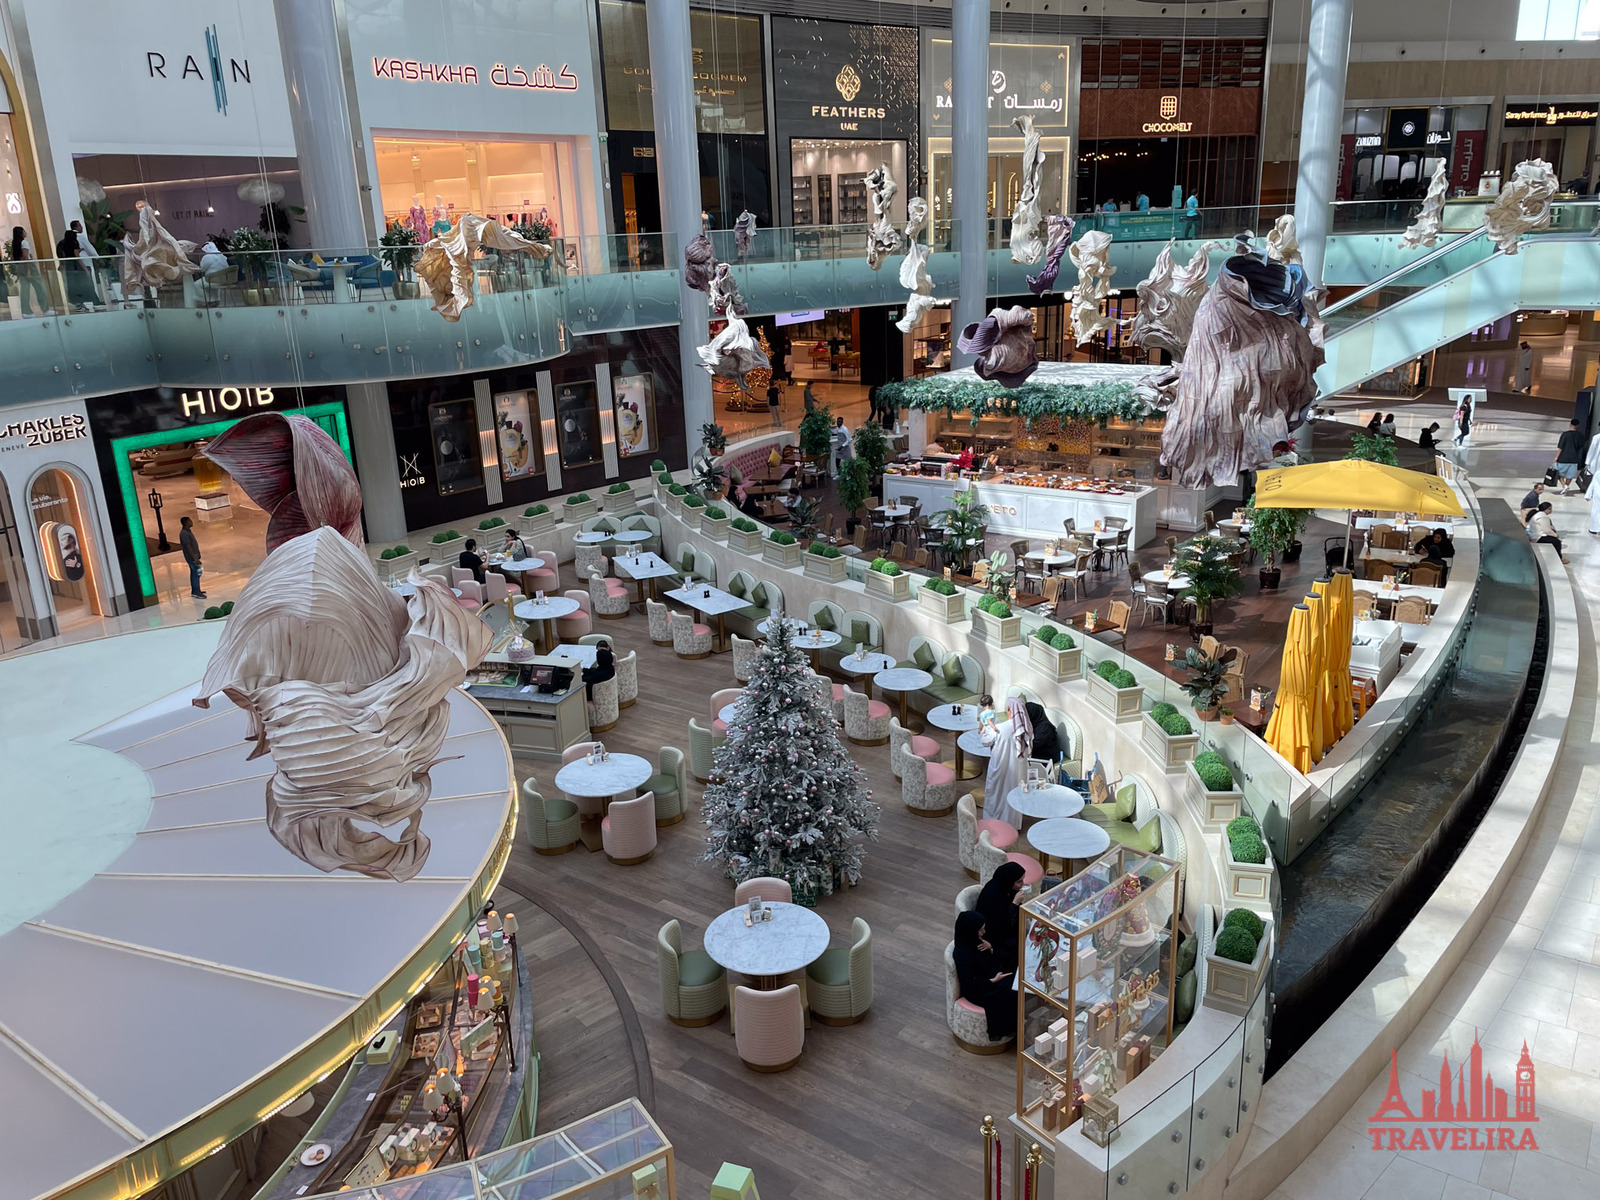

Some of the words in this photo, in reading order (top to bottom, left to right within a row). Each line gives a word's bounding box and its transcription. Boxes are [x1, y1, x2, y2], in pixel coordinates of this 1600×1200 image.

[147, 52, 251, 84] RAIN
[373, 57, 478, 84] KASHKHA
[491, 63, 578, 91] كشخة
[1004, 93, 1063, 112] رمسات
[812, 105, 886, 119] FEATHERS
[840, 122, 858, 131] UAE
[1142, 122, 1193, 133] CHOCOMELT
[1, 443, 25, 453] ENEVE
